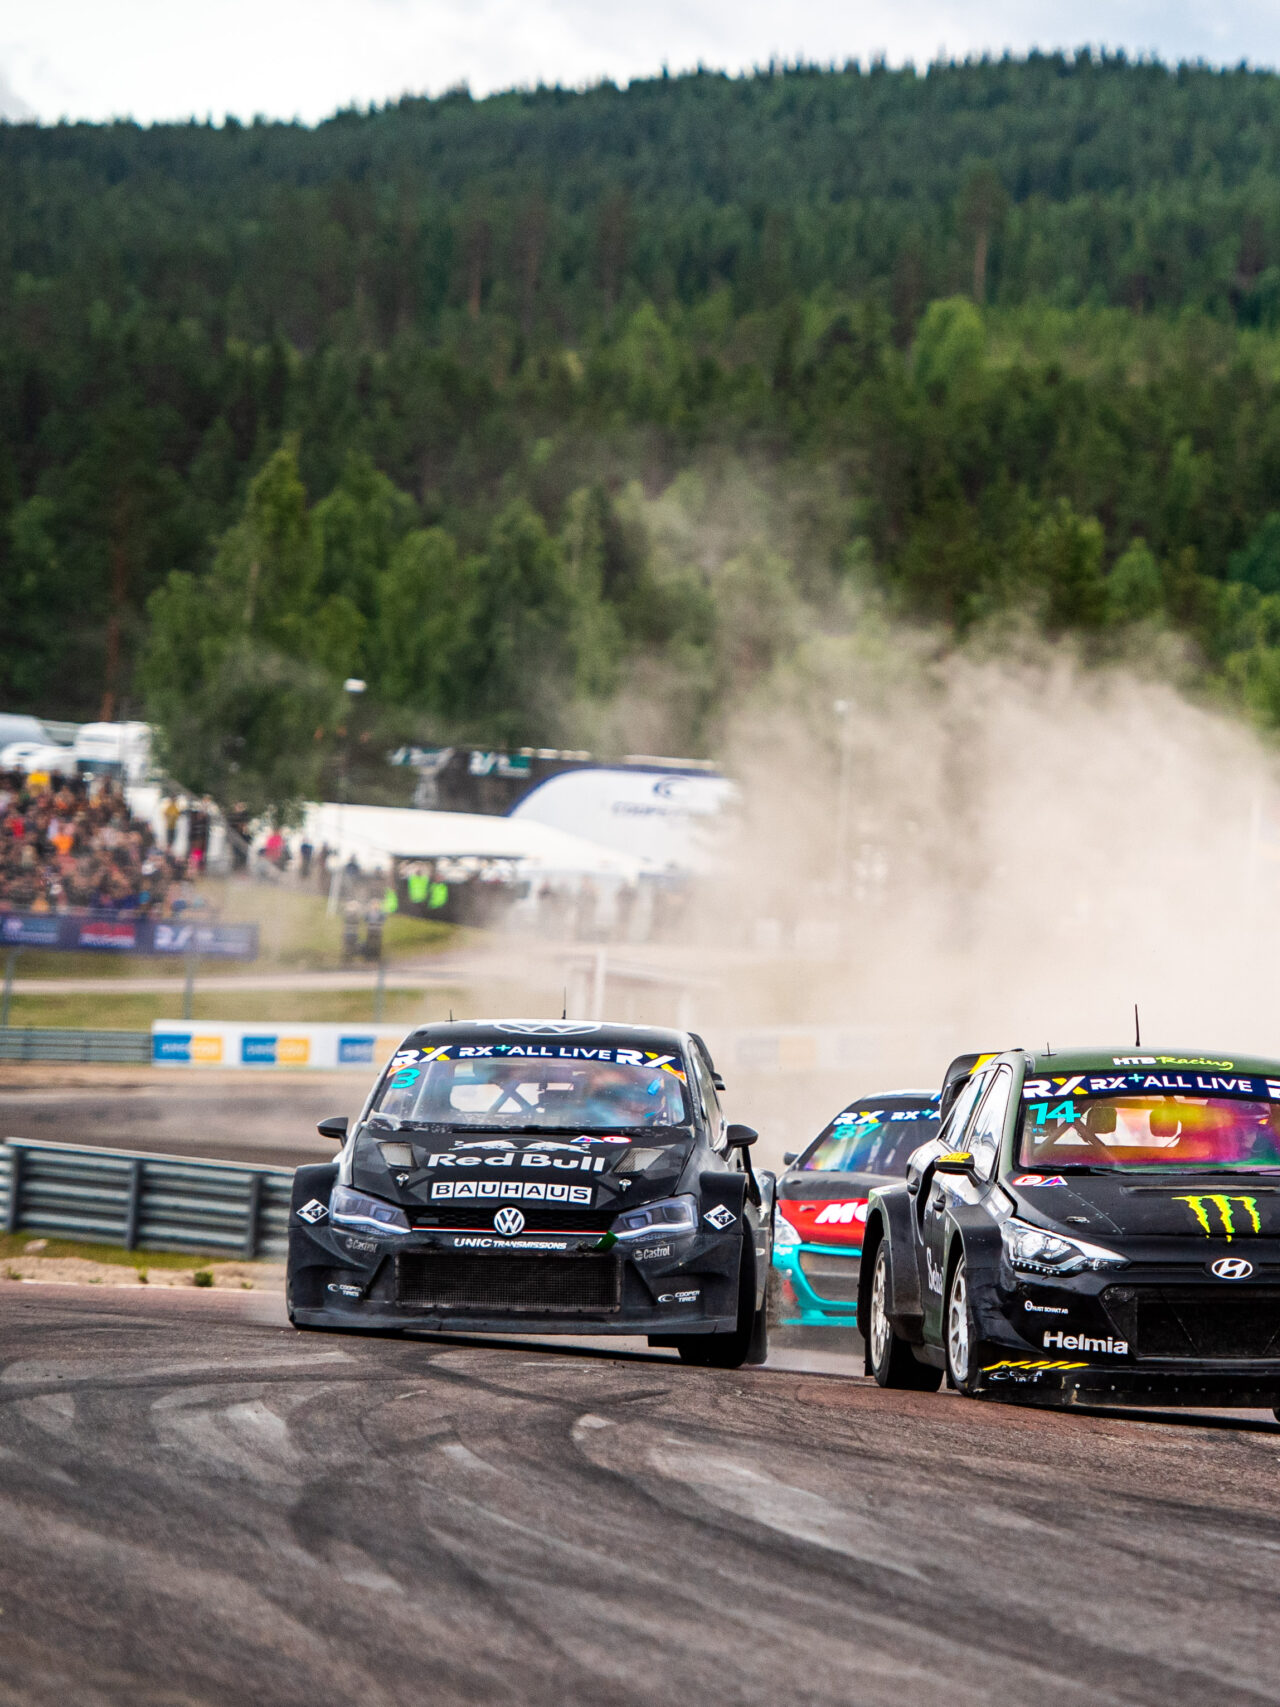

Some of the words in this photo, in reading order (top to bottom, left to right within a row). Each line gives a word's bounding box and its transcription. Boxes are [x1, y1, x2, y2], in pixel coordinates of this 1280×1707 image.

[392, 1045, 453, 1067] RX
[559, 1048, 611, 1060] LIVE
[616, 1049, 679, 1071] RX
[1156, 1056, 1234, 1070] Racing
[390, 1068, 421, 1089] 3
[1022, 1075, 1088, 1098] RX
[1203, 1077, 1253, 1092] LIVE
[833, 1110, 885, 1125] RX
[1028, 1100, 1081, 1126] 14
[427, 1152, 516, 1168] Red
[521, 1153, 606, 1173] Bull
[434, 1183, 590, 1202] BAUHAUS
[454, 1237, 493, 1248] UNIC
[493, 1240, 568, 1250] TRANSMISSIONS
[643, 1245, 671, 1260] Castrol
[674, 1290, 701, 1298] COOPER
[1043, 1330, 1129, 1355] Helmia
